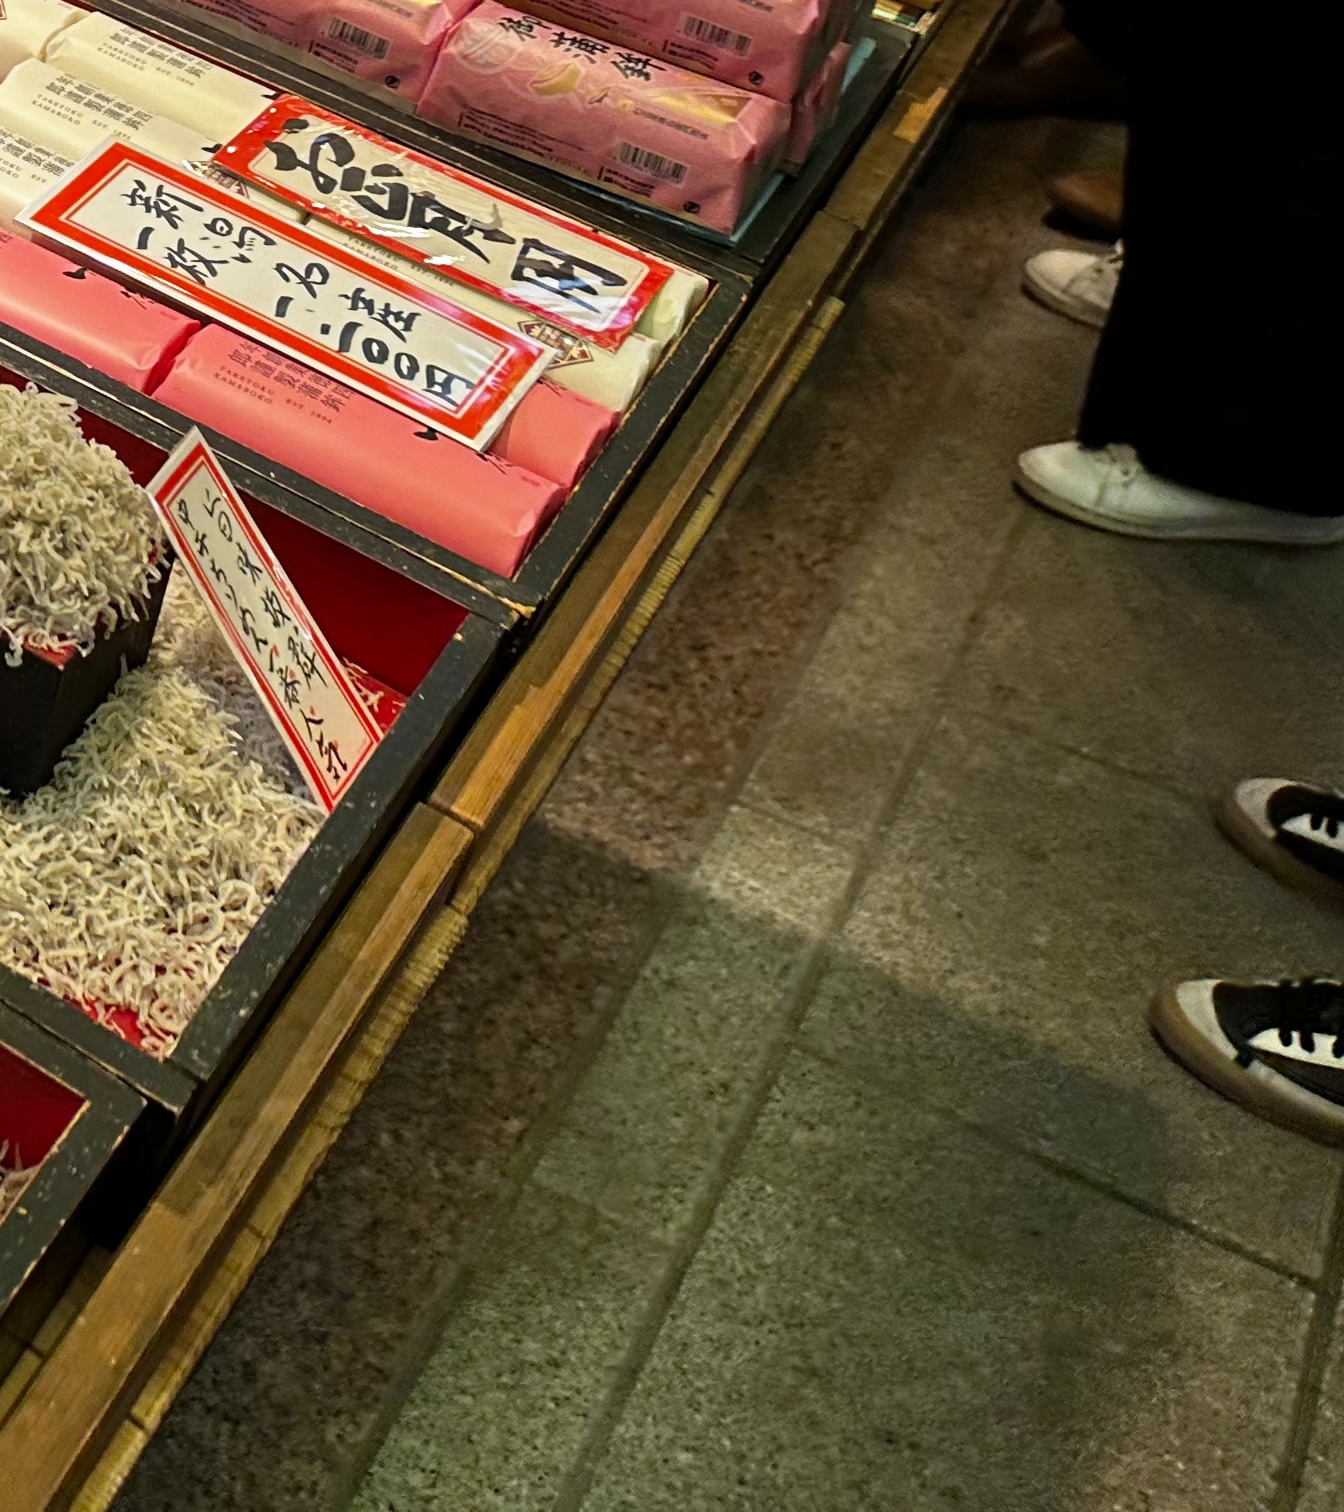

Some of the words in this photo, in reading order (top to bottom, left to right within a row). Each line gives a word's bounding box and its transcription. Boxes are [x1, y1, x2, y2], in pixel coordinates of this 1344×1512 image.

[498, 16, 669, 83] 御蒲鉾
[120, 181, 422, 336] 新潟名産
[263, 118, 628, 313] お正月用
